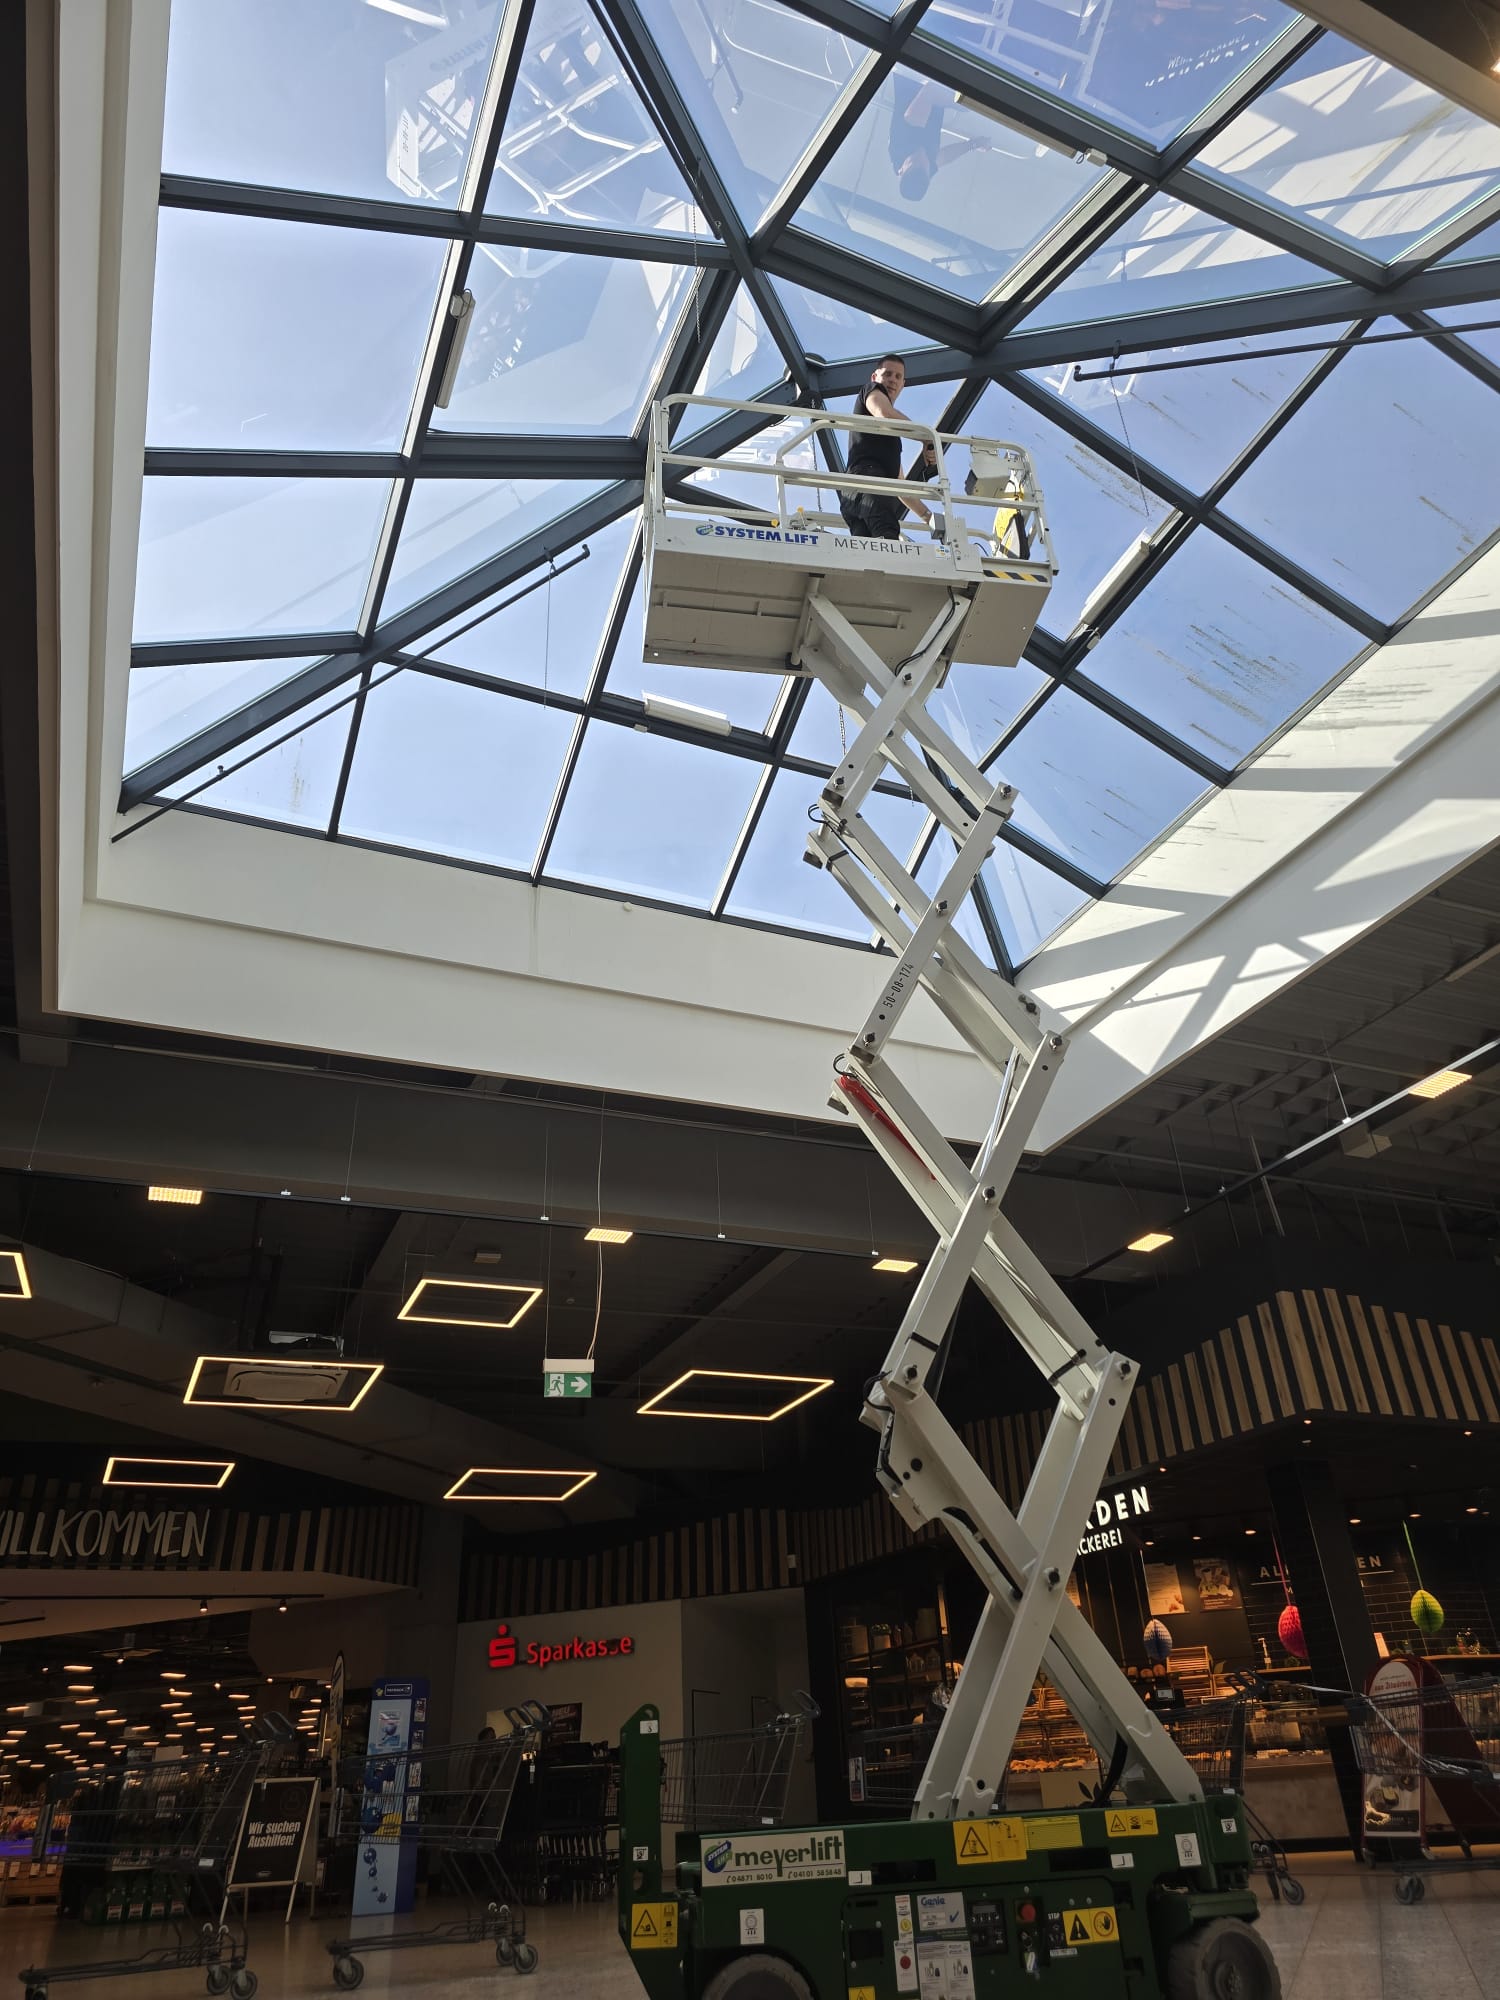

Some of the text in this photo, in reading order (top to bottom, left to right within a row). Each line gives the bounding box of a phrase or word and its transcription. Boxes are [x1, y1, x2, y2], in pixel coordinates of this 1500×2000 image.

[714, 526, 819, 545] SYSTEM LIFT
[834, 537, 923, 556] MEYERLIFT
[882, 963, 914, 1008] 50-08-174
[0, 1507, 211, 1558] ILLKOMMEN
[248, 1820, 301, 1835] Wir suchen
[247, 1833, 297, 1849] Aushilfen!
[735, 1836, 842, 1877] meyerlift
